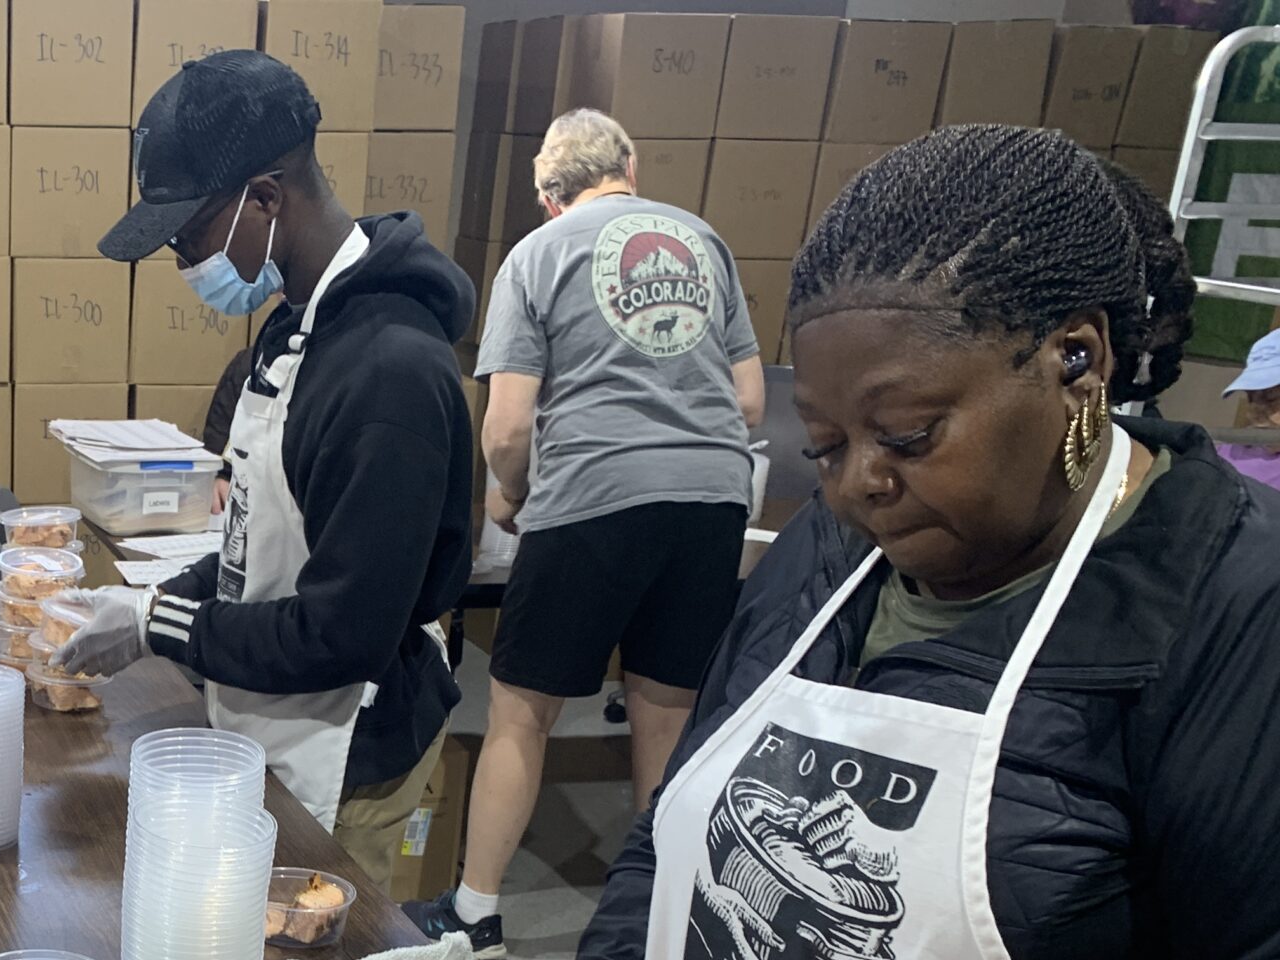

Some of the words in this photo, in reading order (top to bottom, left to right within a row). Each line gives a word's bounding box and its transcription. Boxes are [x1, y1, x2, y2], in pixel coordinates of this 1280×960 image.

[35, 32, 106, 64] IL-302
[377, 47, 445, 87] IL-333
[37, 165, 101, 196] IL-301
[39, 293, 103, 328] IL-300
[617, 280, 708, 315] COLORADO
[753, 733, 919, 804] FOOD
